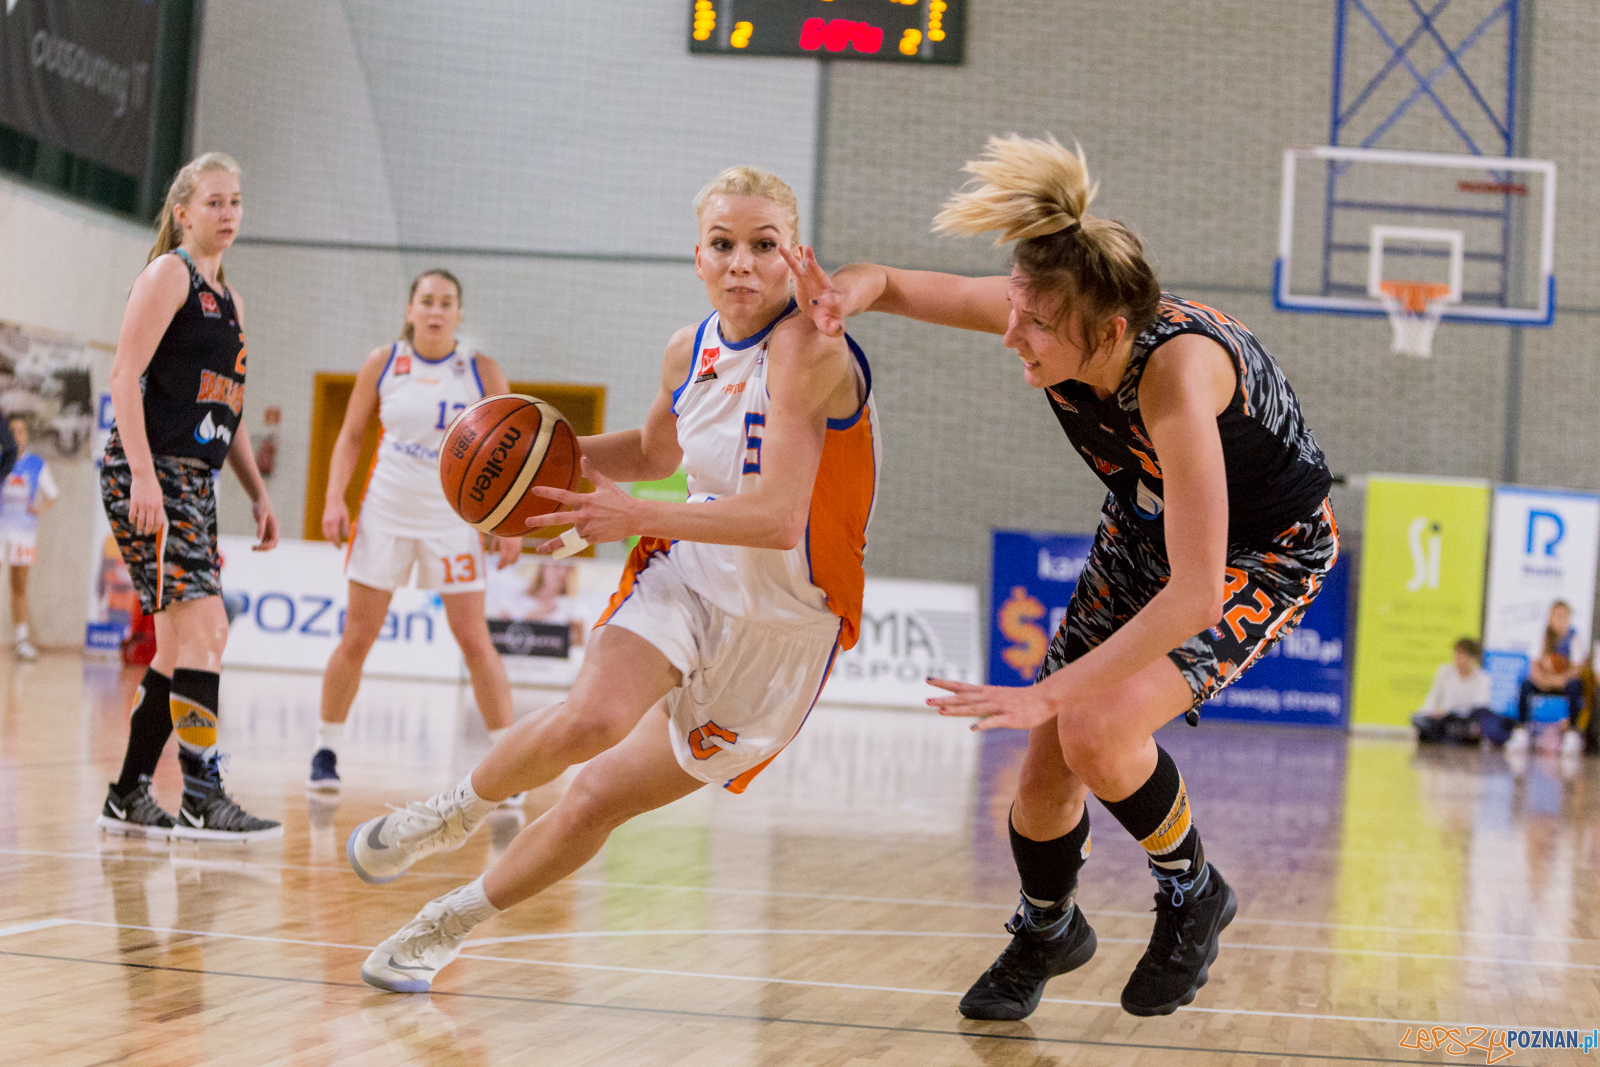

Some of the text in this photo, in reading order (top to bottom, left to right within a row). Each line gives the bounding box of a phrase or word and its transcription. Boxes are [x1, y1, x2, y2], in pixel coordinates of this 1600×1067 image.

[468, 426, 522, 503] molten
[742, 410, 767, 476] 5
[441, 554, 476, 584] 13
